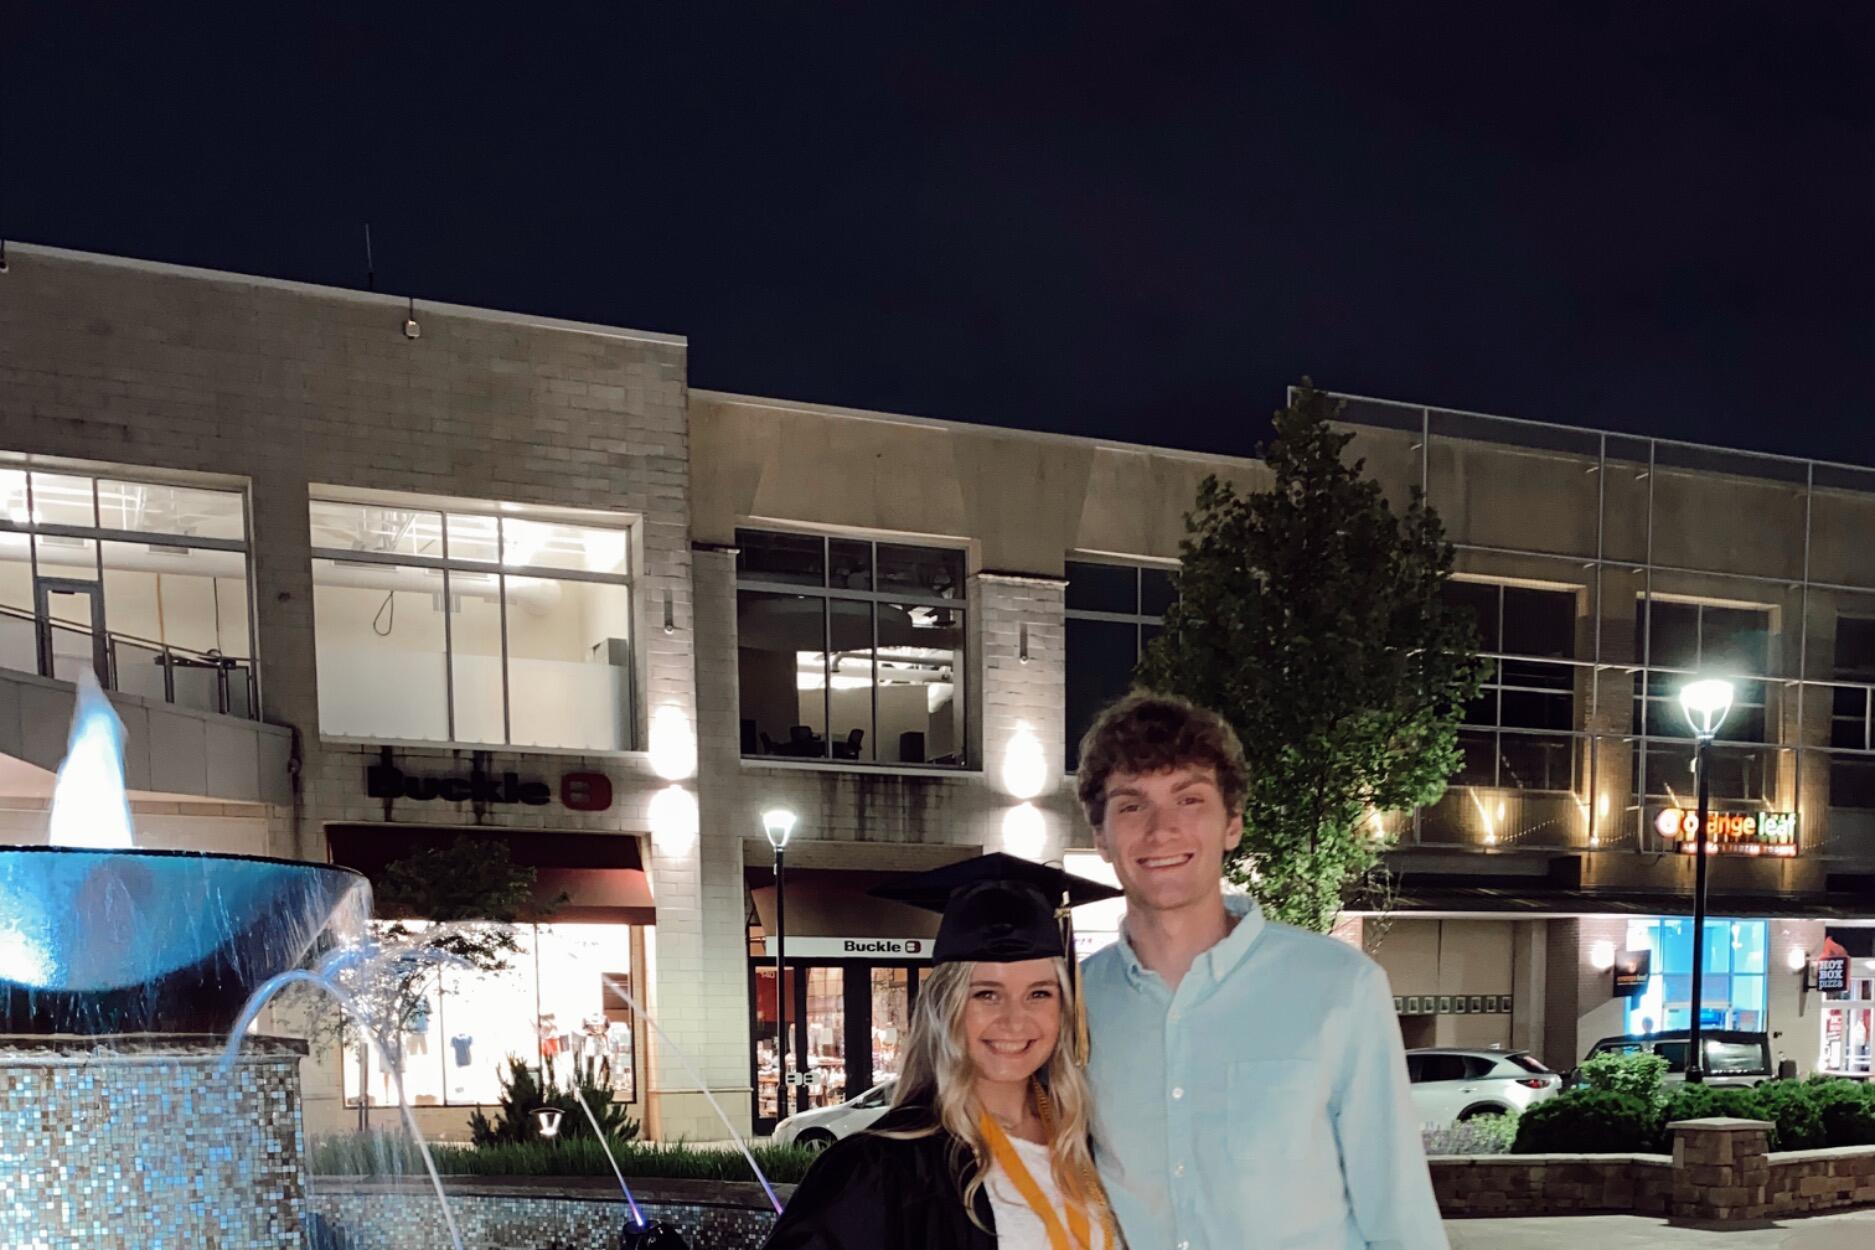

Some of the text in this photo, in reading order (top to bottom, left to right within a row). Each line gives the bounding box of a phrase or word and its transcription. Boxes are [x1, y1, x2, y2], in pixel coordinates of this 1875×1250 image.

[1683, 811, 1797, 837] oange leaf
[844, 940, 901, 952] Buckle
[1819, 959, 1844, 969] HOT
[1819, 970, 1844, 979] BOX
